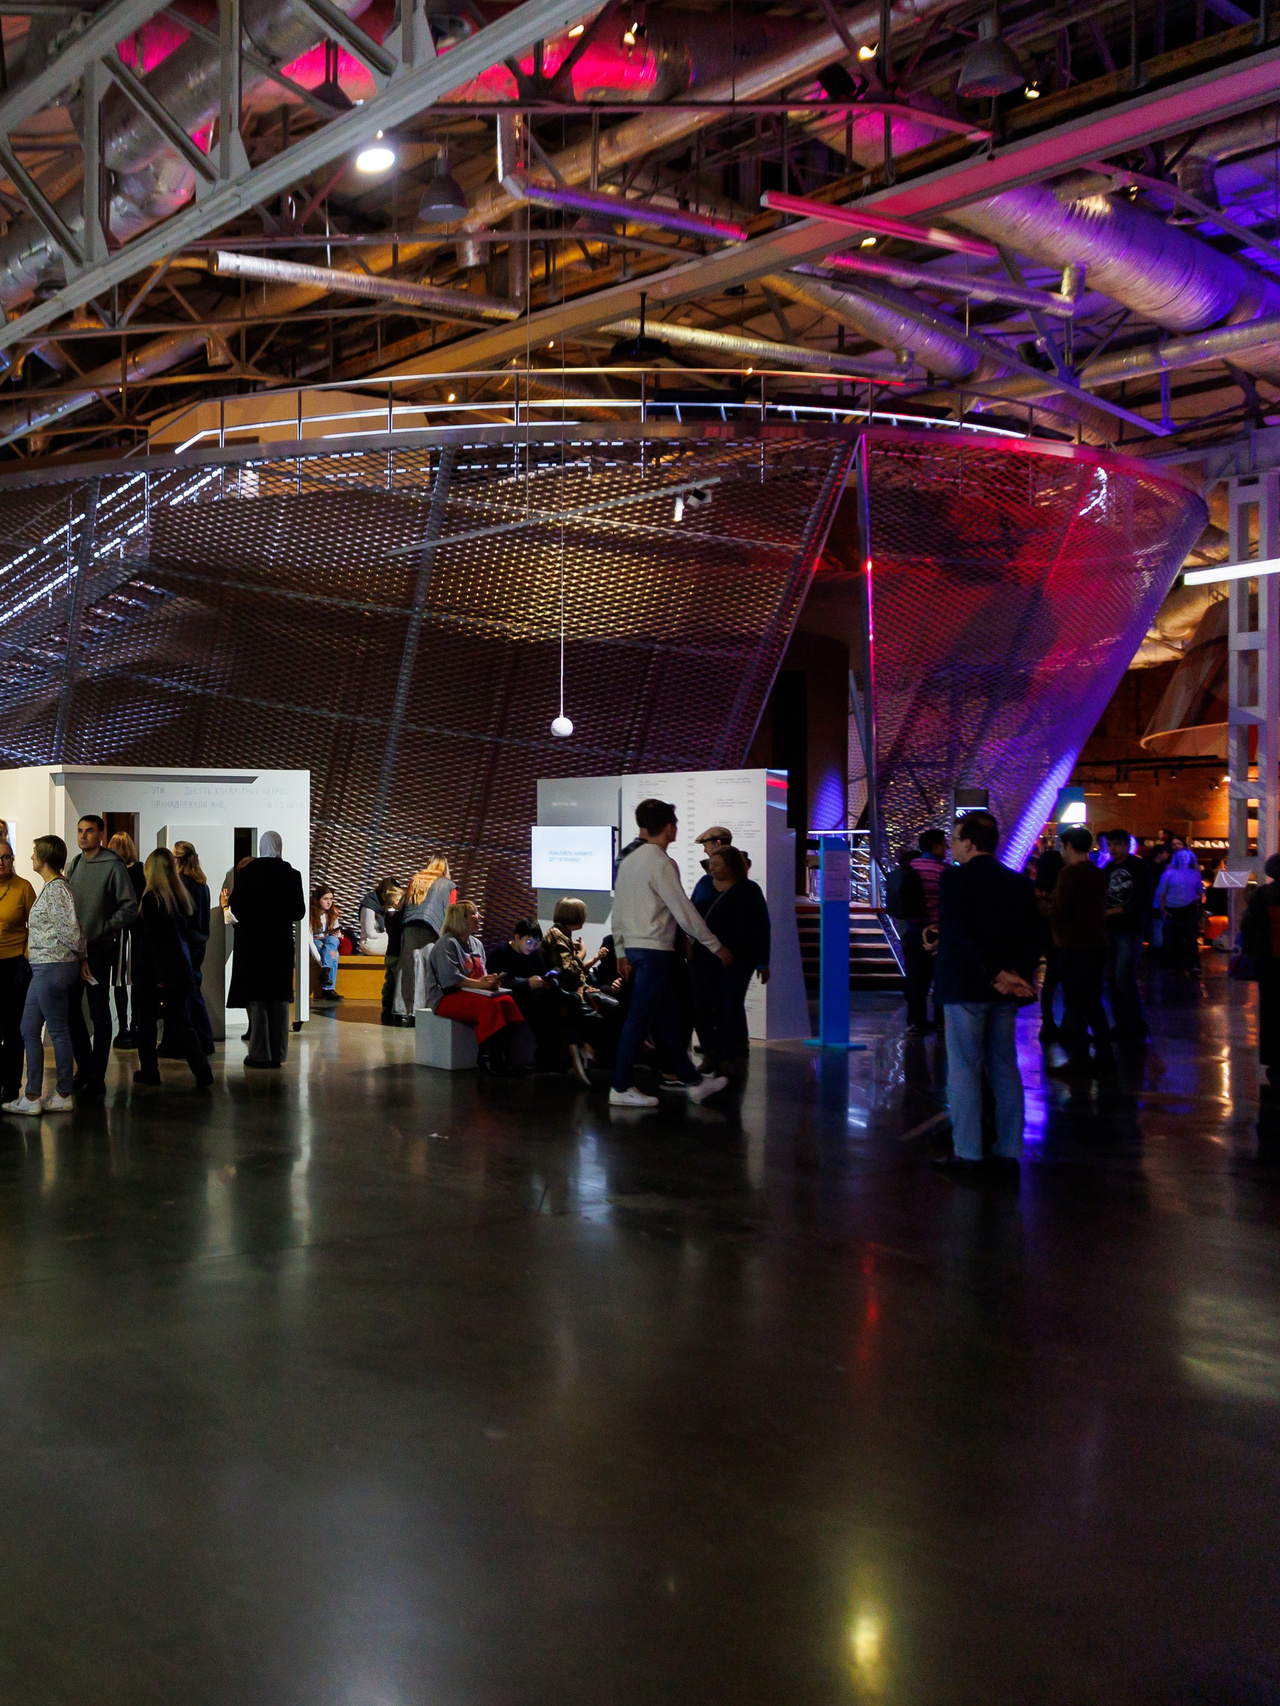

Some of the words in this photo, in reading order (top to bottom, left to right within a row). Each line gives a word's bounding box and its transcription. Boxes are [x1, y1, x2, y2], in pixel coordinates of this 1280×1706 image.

[151, 786, 165, 795] ЭТИ
[184, 787, 212, 796] ДЕСЯТЬ
[151, 800, 207, 809] ПРИНАДЛЕЖАЛИ
